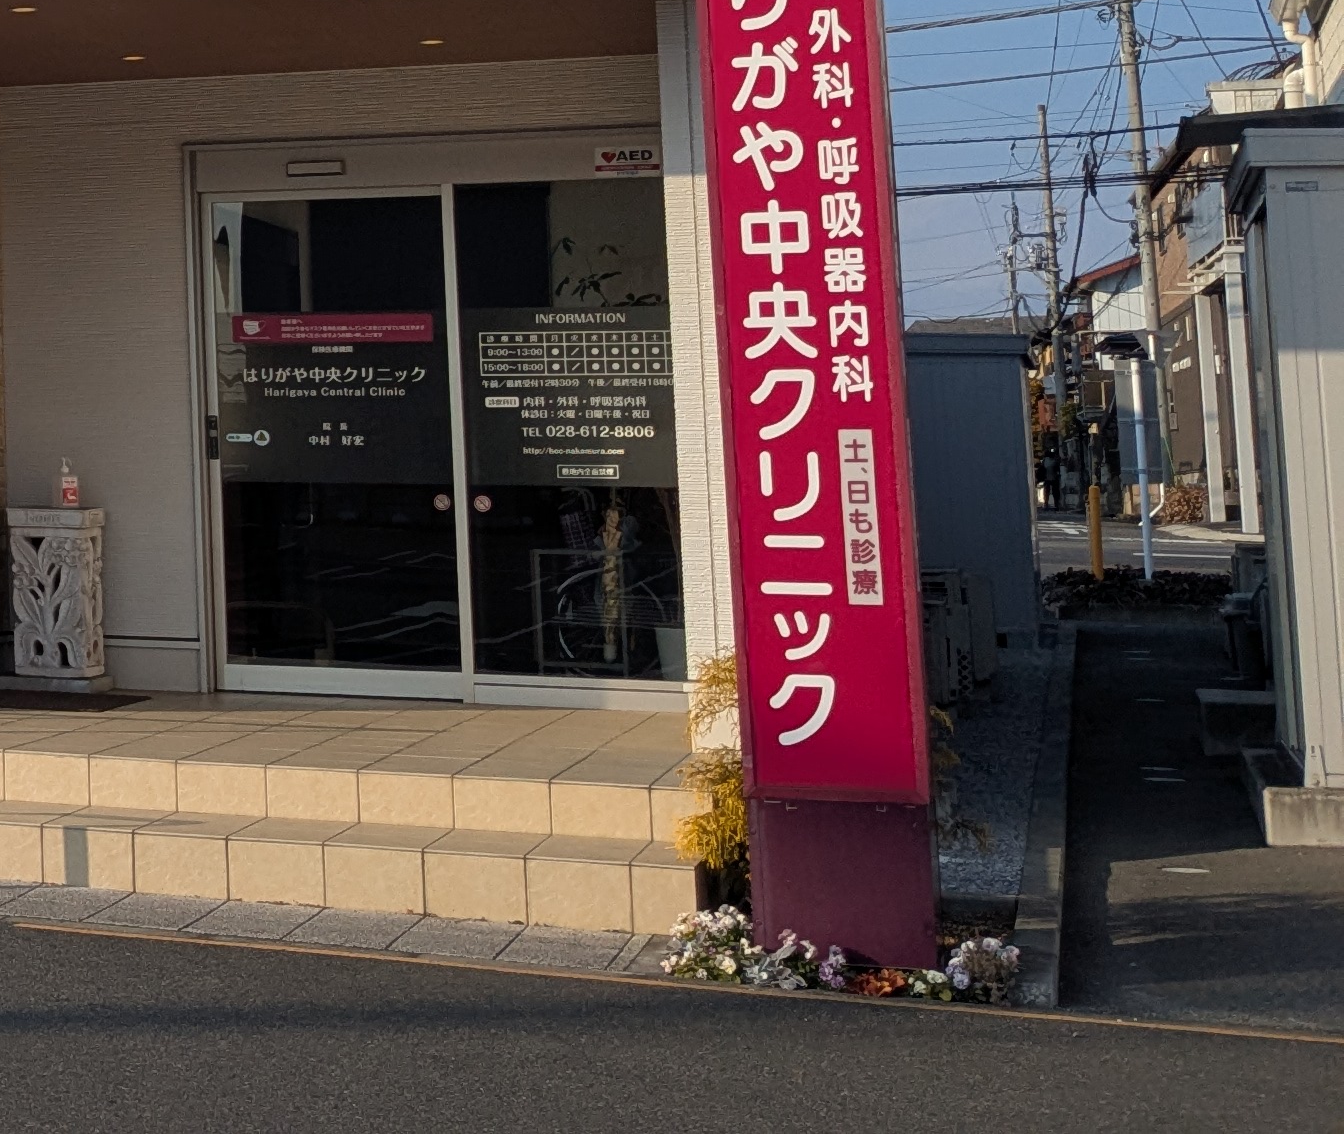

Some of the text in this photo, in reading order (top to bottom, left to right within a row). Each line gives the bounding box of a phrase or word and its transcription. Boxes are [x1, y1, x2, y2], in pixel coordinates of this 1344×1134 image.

[616, 150, 653, 161] AED
[535, 312, 626, 324] INFORMATION
[242, 366, 427, 384] はりがや中央クリニック
[264, 386, 406, 398] Harigaya Central Clinic
[521, 425, 655, 438] TEL 028-612-8806
[843, 438, 879, 596] 土、日も診療
